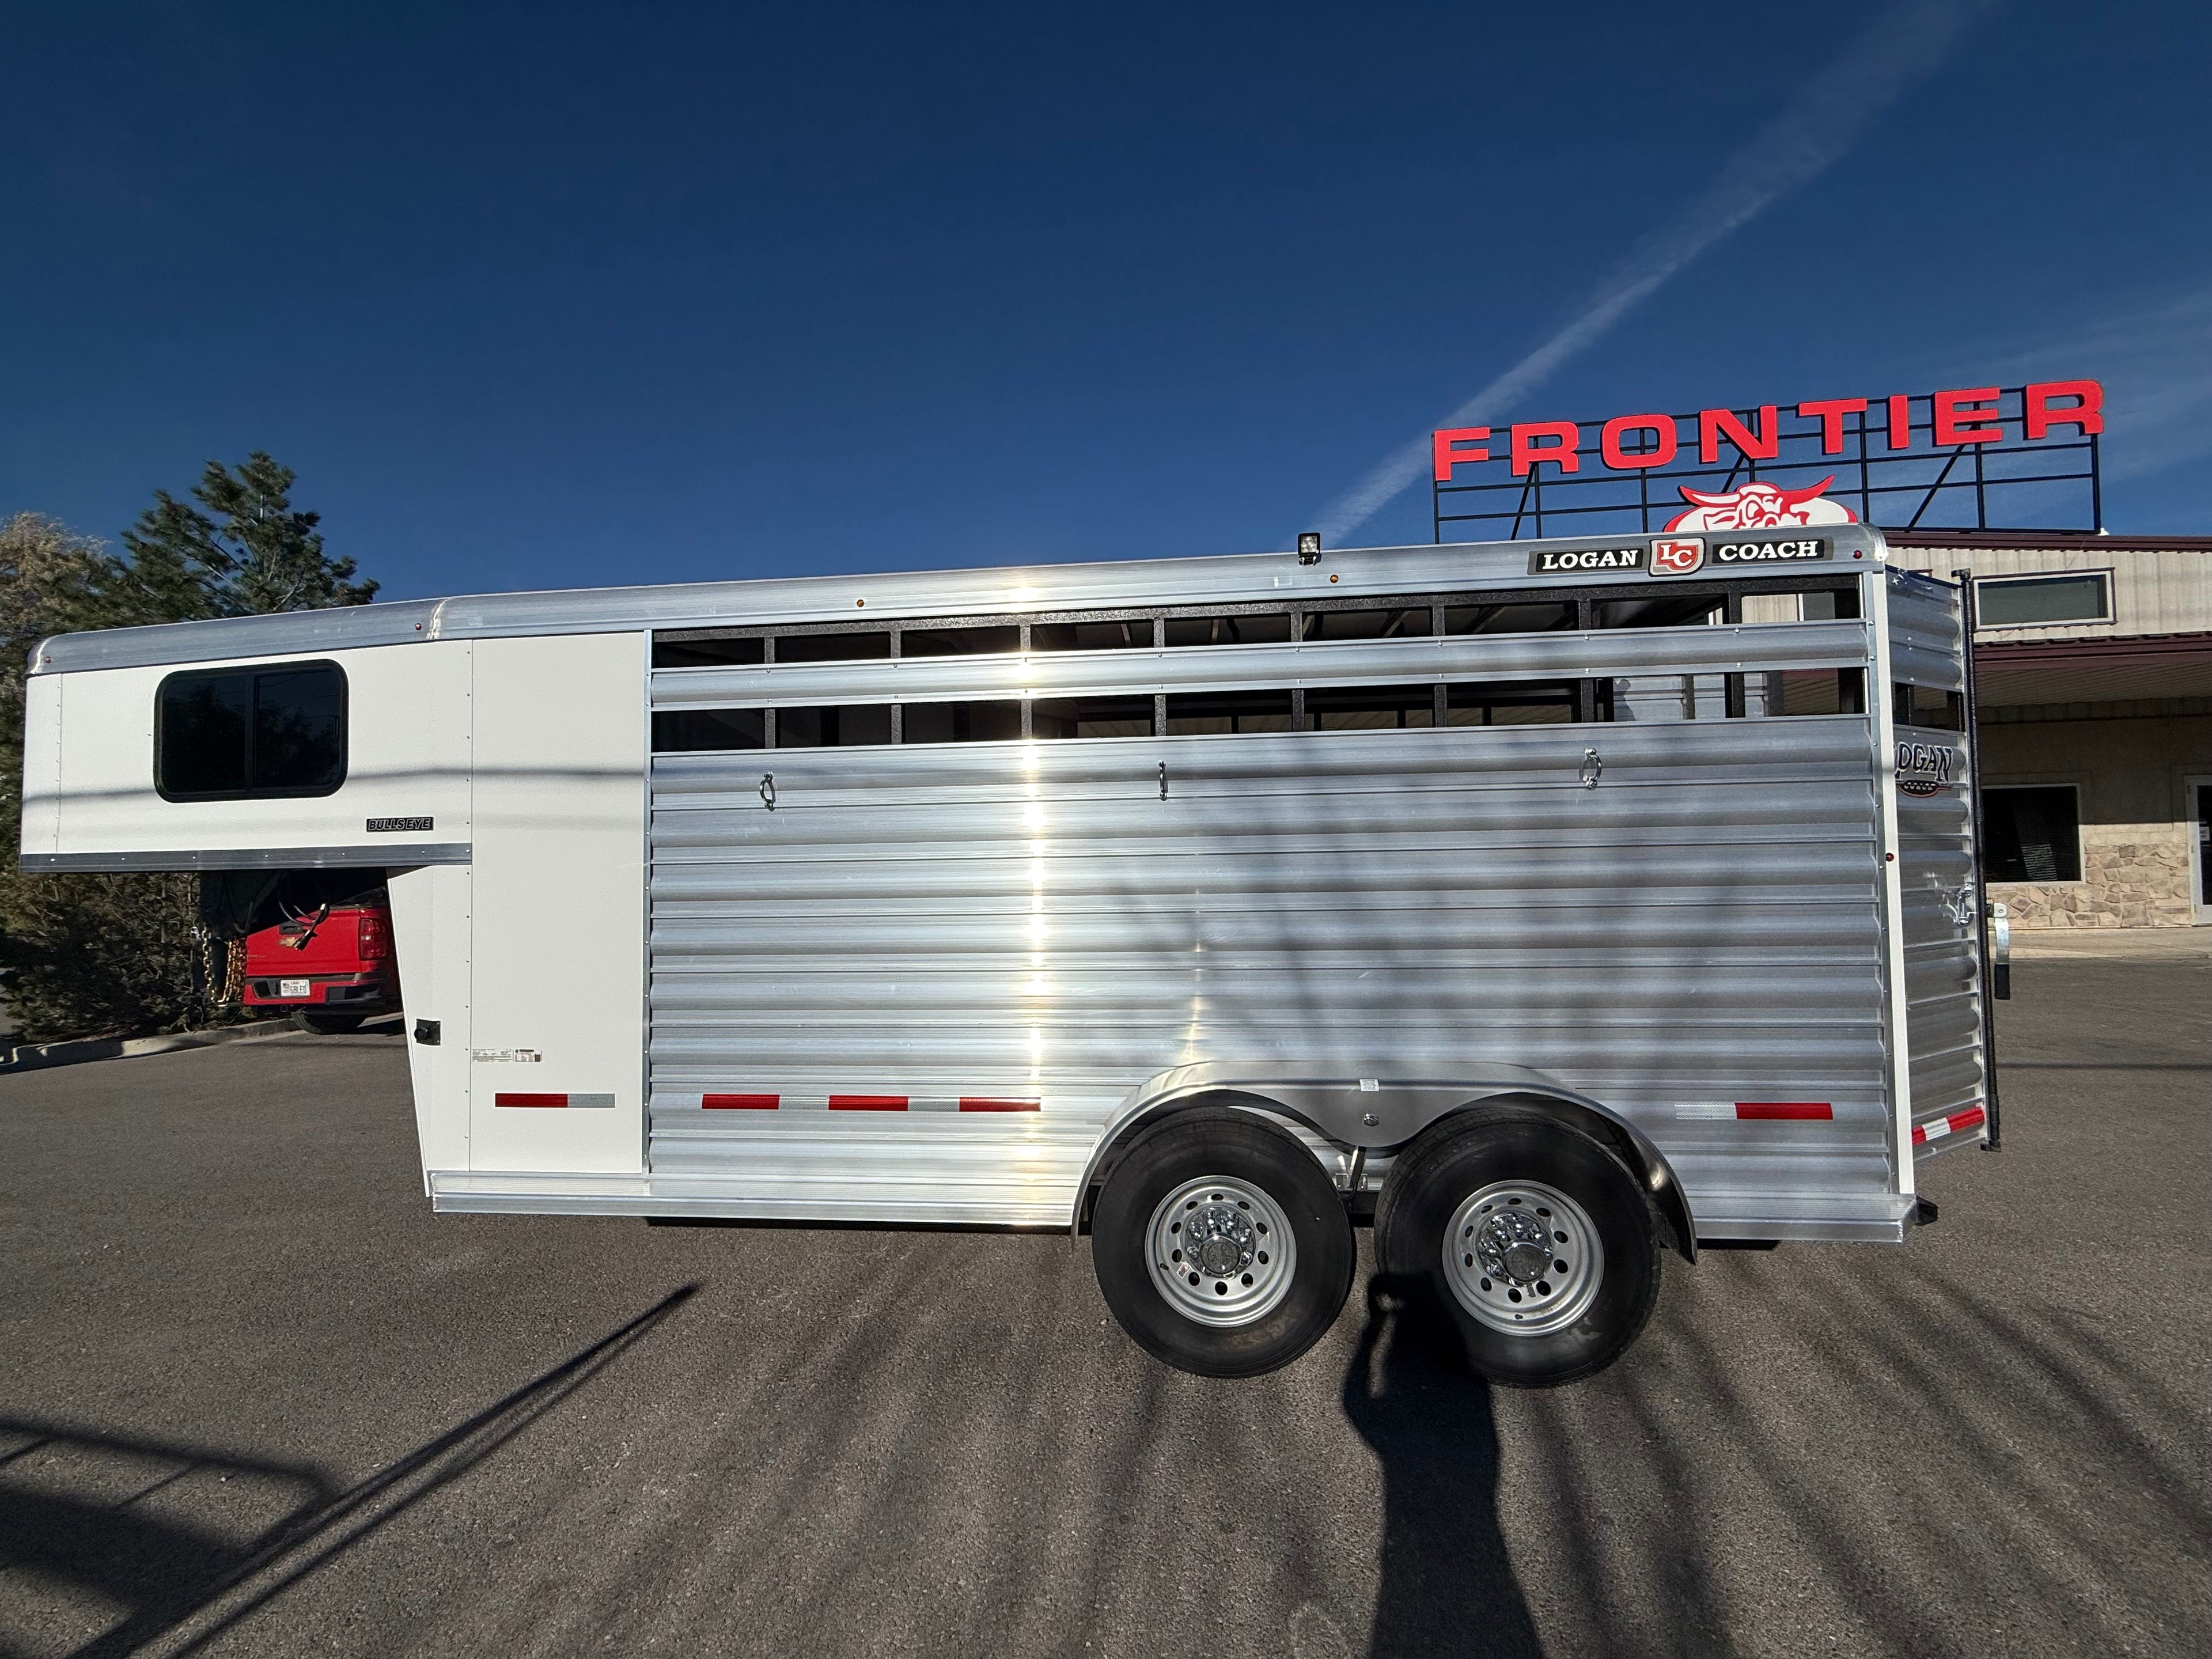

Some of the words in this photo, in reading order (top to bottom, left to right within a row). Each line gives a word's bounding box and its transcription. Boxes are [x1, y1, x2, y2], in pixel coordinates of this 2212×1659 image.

[1434, 379, 2104, 480] FRONTIER
[1542, 550, 1639, 570] LOGAN
[1660, 544, 1692, 567] LC
[1718, 540, 1818, 561] COACH
[1895, 741, 1953, 782] OGAN
